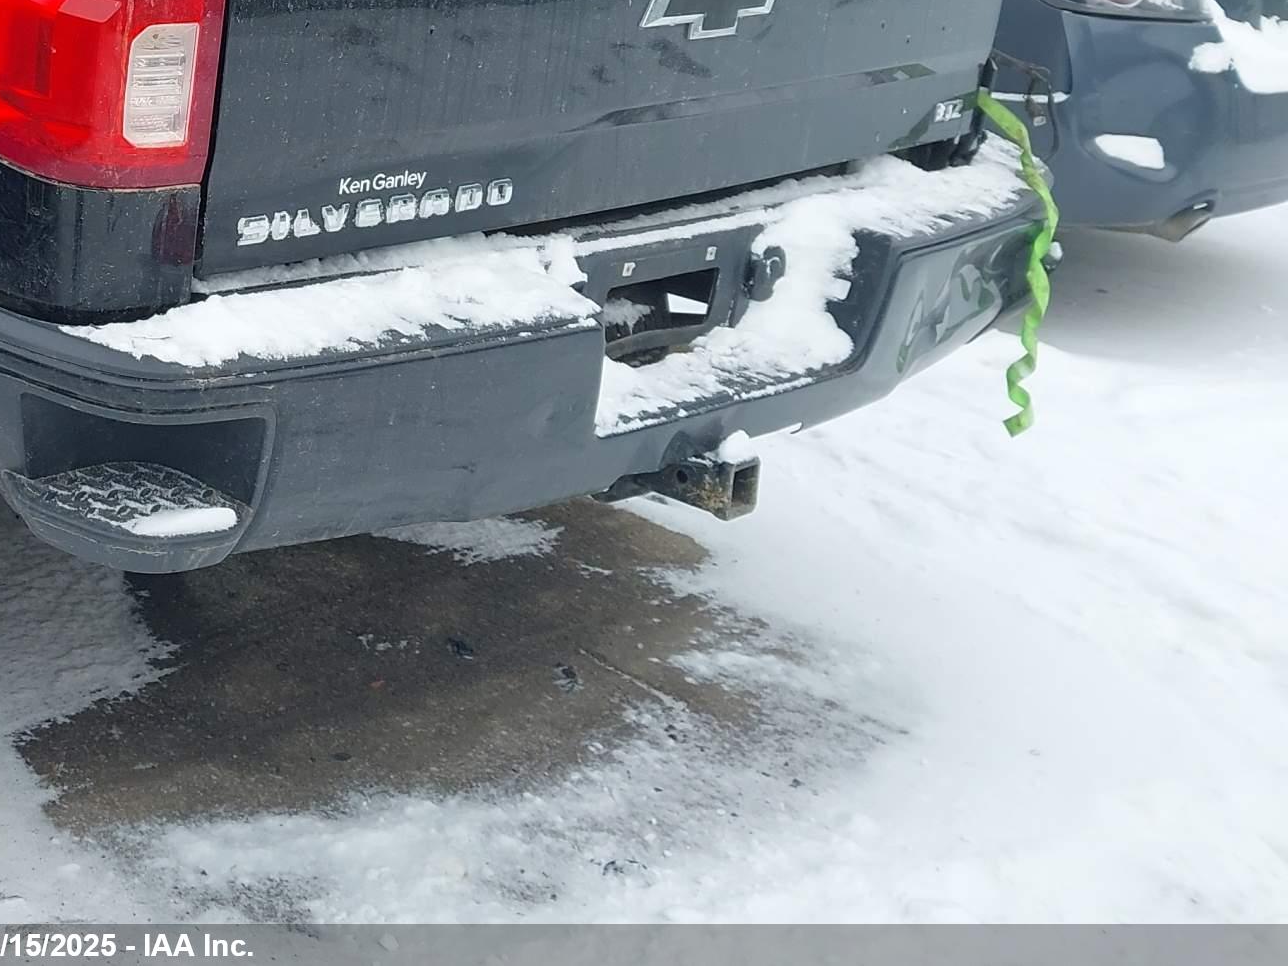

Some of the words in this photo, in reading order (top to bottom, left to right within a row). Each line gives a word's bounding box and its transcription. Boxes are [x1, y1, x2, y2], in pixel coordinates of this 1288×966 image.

[339, 176, 370, 195] Ken
[372, 171, 428, 190] Ganley
[237, 179, 513, 247] SILVERADO
